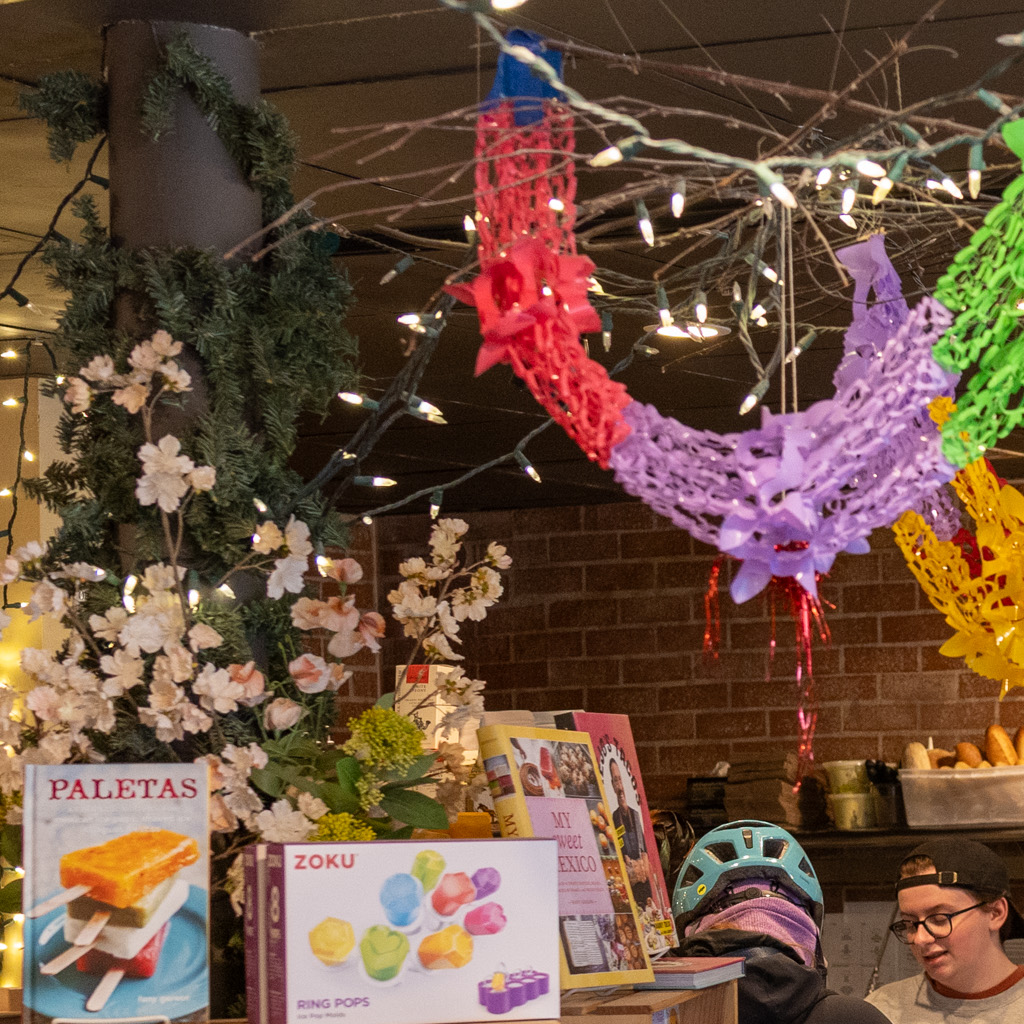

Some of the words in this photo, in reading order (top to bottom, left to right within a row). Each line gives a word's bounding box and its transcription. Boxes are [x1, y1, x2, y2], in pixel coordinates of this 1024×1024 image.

[49, 778, 198, 800] PALETAS
[551, 812, 571, 829] MY
[294, 854, 355, 870] ZOKU
[557, 855, 597, 872] EXICO
[297, 999, 331, 1010] RING
[335, 997, 370, 1009] POPS
